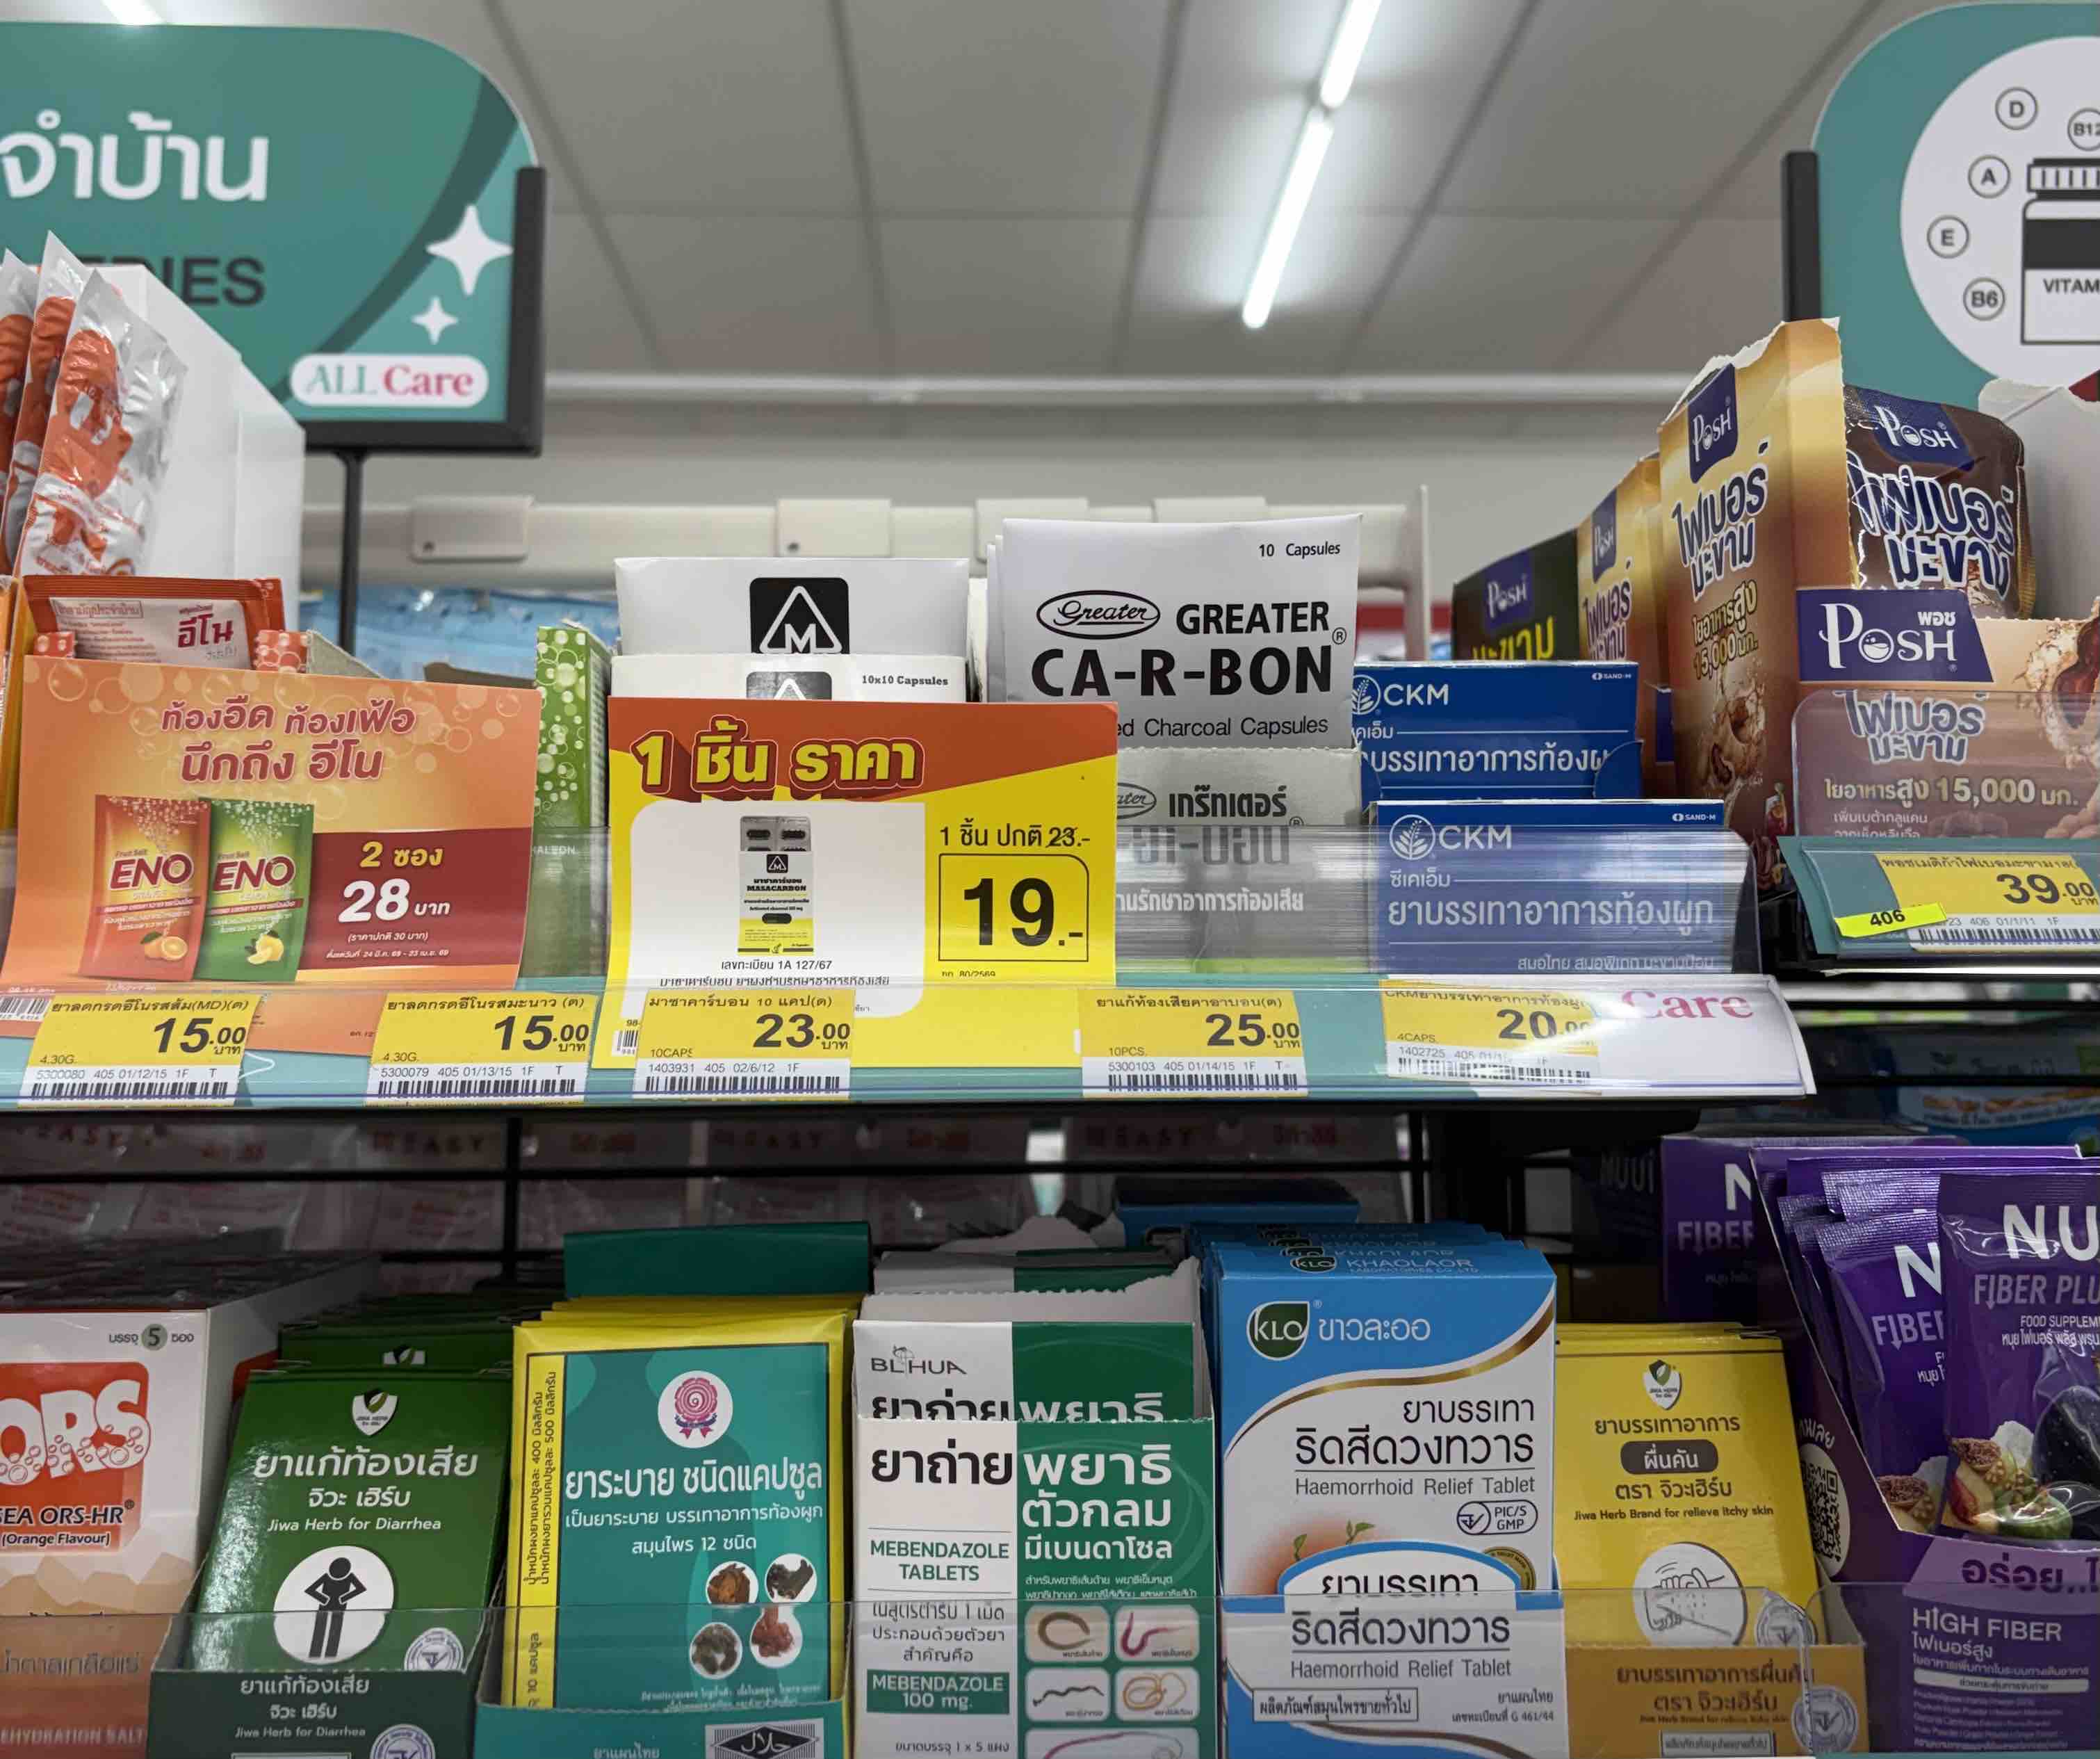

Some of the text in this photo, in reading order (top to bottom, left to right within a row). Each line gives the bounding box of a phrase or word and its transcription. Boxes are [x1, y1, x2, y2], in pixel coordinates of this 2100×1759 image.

[2009, 101, 2024, 118] D
[1981, 168, 1996, 185] A
[1941, 229, 1954, 246] E
[1971, 291, 1998, 308] B6
[307, 364, 473, 396] ALL Care
[1691, 396, 1733, 464] POSH
[1875, 405, 1959, 449] POSH
[1259, 542, 1340, 559] 10 Capsules
[1052, 600, 1330, 635] Greater GREATER
[1917, 610, 1957, 627] พอช
[177, 613, 234, 648] อีโน
[1818, 602, 1957, 670] POSH
[862, 675, 949, 686] 10x10 Capsules
[1031, 645, 1332, 697] CA-R-BON
[1383, 683, 1450, 706] CKM
[161, 694, 417, 736] ท้องอืด ท้องเฟ้อ
[1144, 715, 1329, 740] Charcoal Capsules
[181, 737, 384, 784] นึกถึง อีโน
[635, 719, 915, 787] 1 ชิ้น ราคา
[1937, 778, 2080, 807] 15,000 มก.
[959, 818, 1043, 847] ชิ้น ปกติ
[1439, 824, 1513, 850] CKM
[360, 841, 444, 868] 2 ซอง
[110, 854, 194, 890] ENO
[213, 856, 295, 892] ENO
[1389, 869, 1451, 888] ซีเคเอ็ม
[338, 877, 451, 923] 28 บาท
[1996, 873, 2095, 904] 39.00
[1388, 891, 1714, 937] ยาบรรเทาอาการท้องผูก
[1870, 909, 1907, 927] 406
[1971, 917, 1991, 926] 406
[394, 933, 406, 941] 30
[721, 959, 833, 971] เลขทะเบียน 1A 127/67
[649, 994, 772, 1008] มาซาคาร์บอน 10
[1621, 990, 1754, 1019] Care
[153, 1016, 247, 1054] 15.00
[493, 1014, 589, 1051] 15.00
[752, 1013, 852, 1048] 23.00
[1205, 1014, 1301, 1048] 25.00
[213, 1045, 242, 1055] บาท
[558, 1041, 587, 1053] บาท
[821, 1040, 849, 1051] บาท
[1273, 1039, 1301, 1049] บาท
[36, 1069, 217, 1080] 5300080 405 01/12/15 1F T
[380, 1065, 563, 1077] 5300079 405 01/13/15 1F T
[649, 1062, 801, 1073] 1403931 405 02/6/12 1F
[1108, 1061, 1283, 1071] 5300103 405 01/14/15 1F T
[1974, 1274, 2046, 1311] FIBER
[1254, 1320, 1304, 1341] KLO
[1318, 1318, 1431, 1342] ขาวละออ
[2020, 1316, 2047, 1327] FOOD
[108, 1328, 161, 1346] บรรจุ 5
[1403, 1399, 1534, 1423] ยาบรรเทา
[0, 1379, 152, 1486] ORS
[1595, 1416, 1741, 1434] ยาบรรเทาอาการ
[531, 1440, 542, 1464] 400
[1295, 1425, 1533, 1466] ริดสีดวงทวาร
[1643, 1444, 1699, 1470] ผื่นคัน
[252, 1445, 479, 1479] ยาแก้ท้องเสีย
[871, 1438, 1173, 1486] ยาถ่าย พยาธิ
[565, 1457, 822, 1502] ยาระบาย ชนิดแคปซูล
[1295, 1476, 1536, 1496] Haemorrhoid Relief Tablet
[308, 1487, 347, 1508] จิวะ
[1615, 1483, 1652, 1500] ตรา
[40, 1506, 124, 1525] ORS-HR
[565, 1502, 824, 1528] เป็นยาระบาย บรรเทาอาการท้องผูก
[1022, 1489, 1171, 1528] ตัวกลม
[1494, 1505, 1527, 1518] PIC/S
[1574, 1509, 1597, 1521] Jiwa
[1600, 1509, 1627, 1520] Herb
[1629, 1509, 1661, 1519] Brand
[1664, 1507, 1679, 1518] for
[1752, 1505, 1774, 1515] skin
[267, 1517, 442, 1532] Jiwa Herb for Diarrhea
[1496, 1518, 1524, 1530] GMP
[1, 1532, 111, 1547] (Orange Flavour)
[631, 1534, 757, 1558] สมุนไพร 12 ชนิด
[870, 1540, 1009, 1560] MEBENDAZOLE
[1024, 1533, 1173, 1561] มีเบนดาโซล
[898, 1563, 979, 1581] TABLETS
[1292, 1607, 1510, 1646] ริดสีดวงทวาร
[1913, 1607, 2062, 1642] HIGH FIBER
[1290, 1659, 1512, 1679] Haemorrhoid Relief Tablet
[240, 1673, 371, 1696] ยาแก้ท้องเสีย
[872, 1674, 1004, 1692] MEBENDAZOLE
[903, 1692, 973, 1712] 100 mg.
[1653, 1694, 1693, 1712] ตรา
[263, 1726, 292, 1737] Herb
[295, 1727, 313, 1737] for
[741, 1732, 792, 1755] حلال
